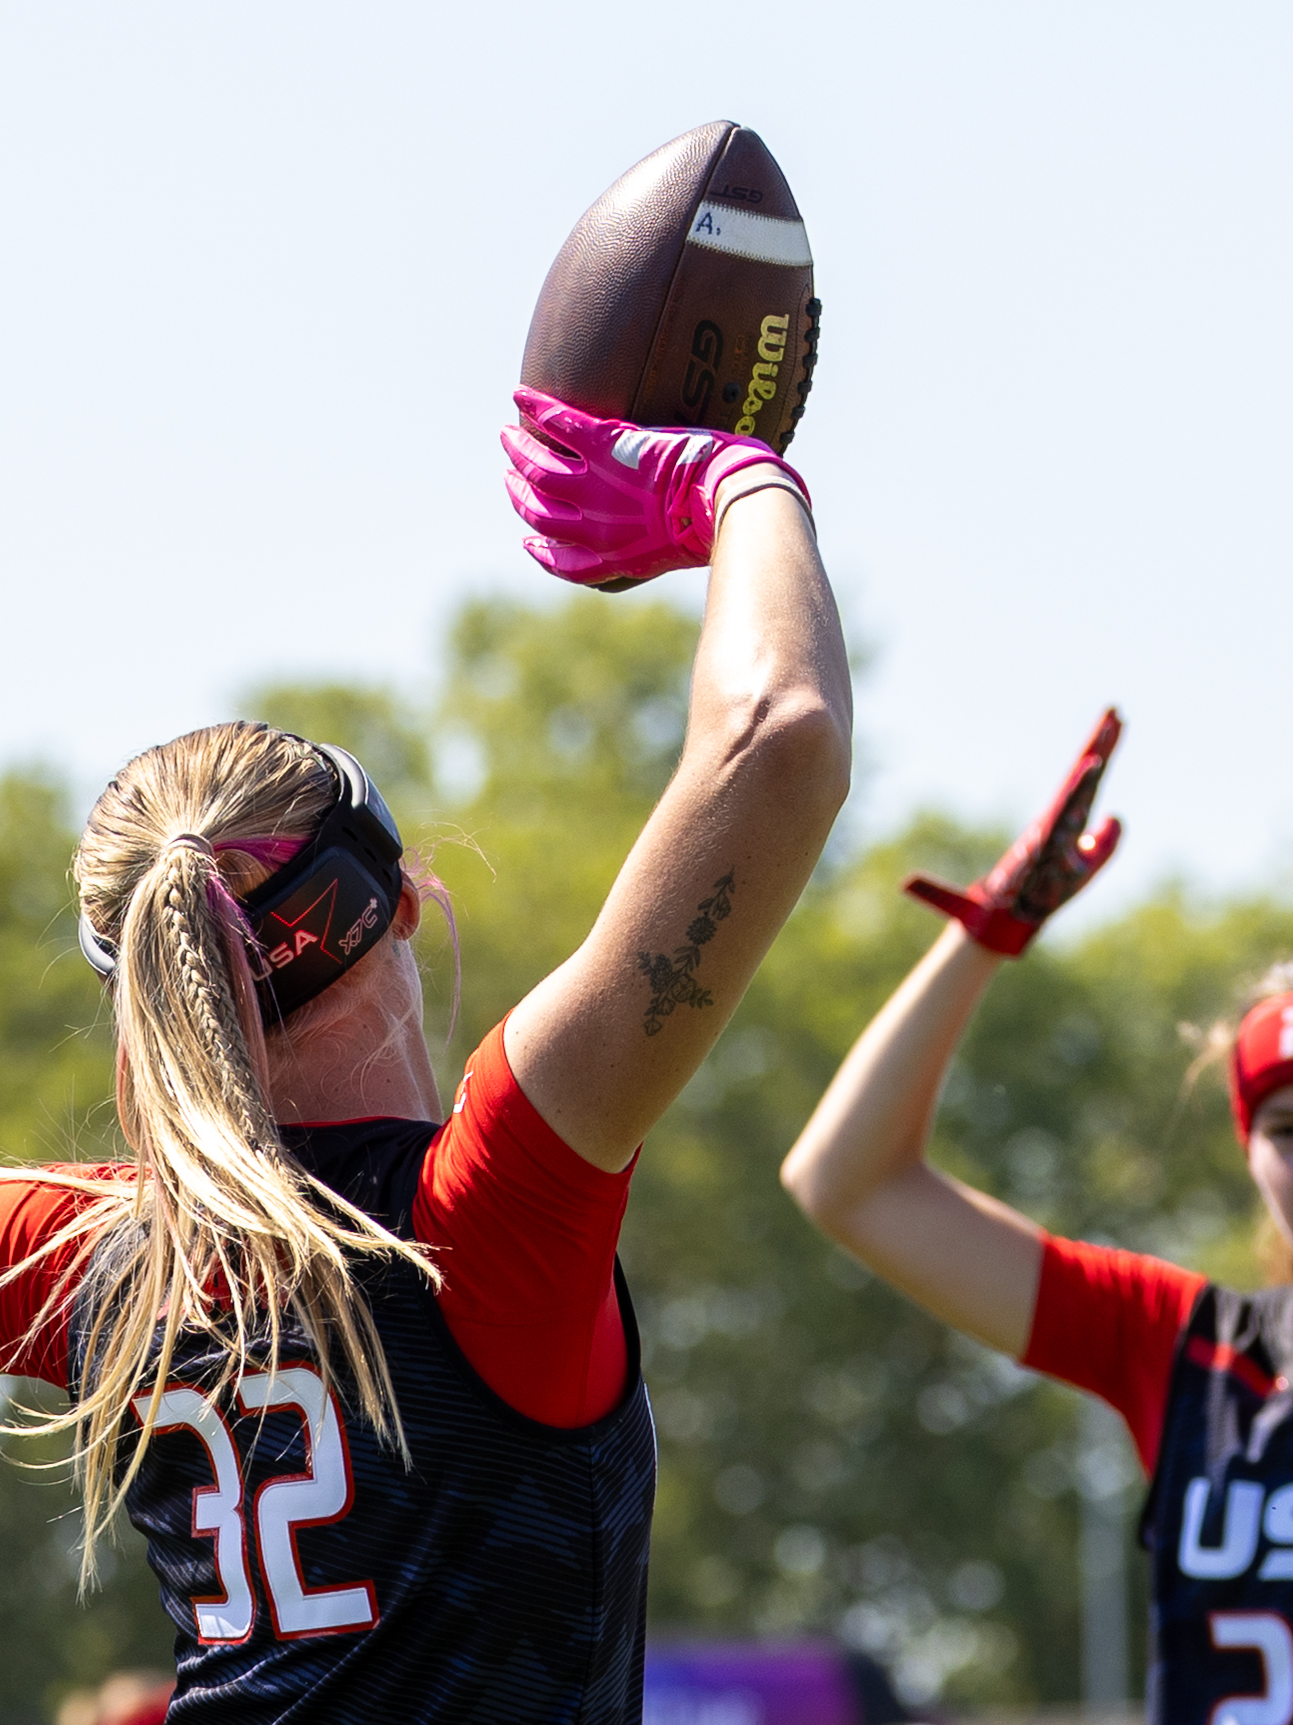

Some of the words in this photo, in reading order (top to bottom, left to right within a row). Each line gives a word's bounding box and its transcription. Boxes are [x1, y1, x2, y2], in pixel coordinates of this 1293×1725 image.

[709, 184, 764, 205] GST
[734, 313, 790, 437] Wilso
[129, 1360, 379, 1646] 32
